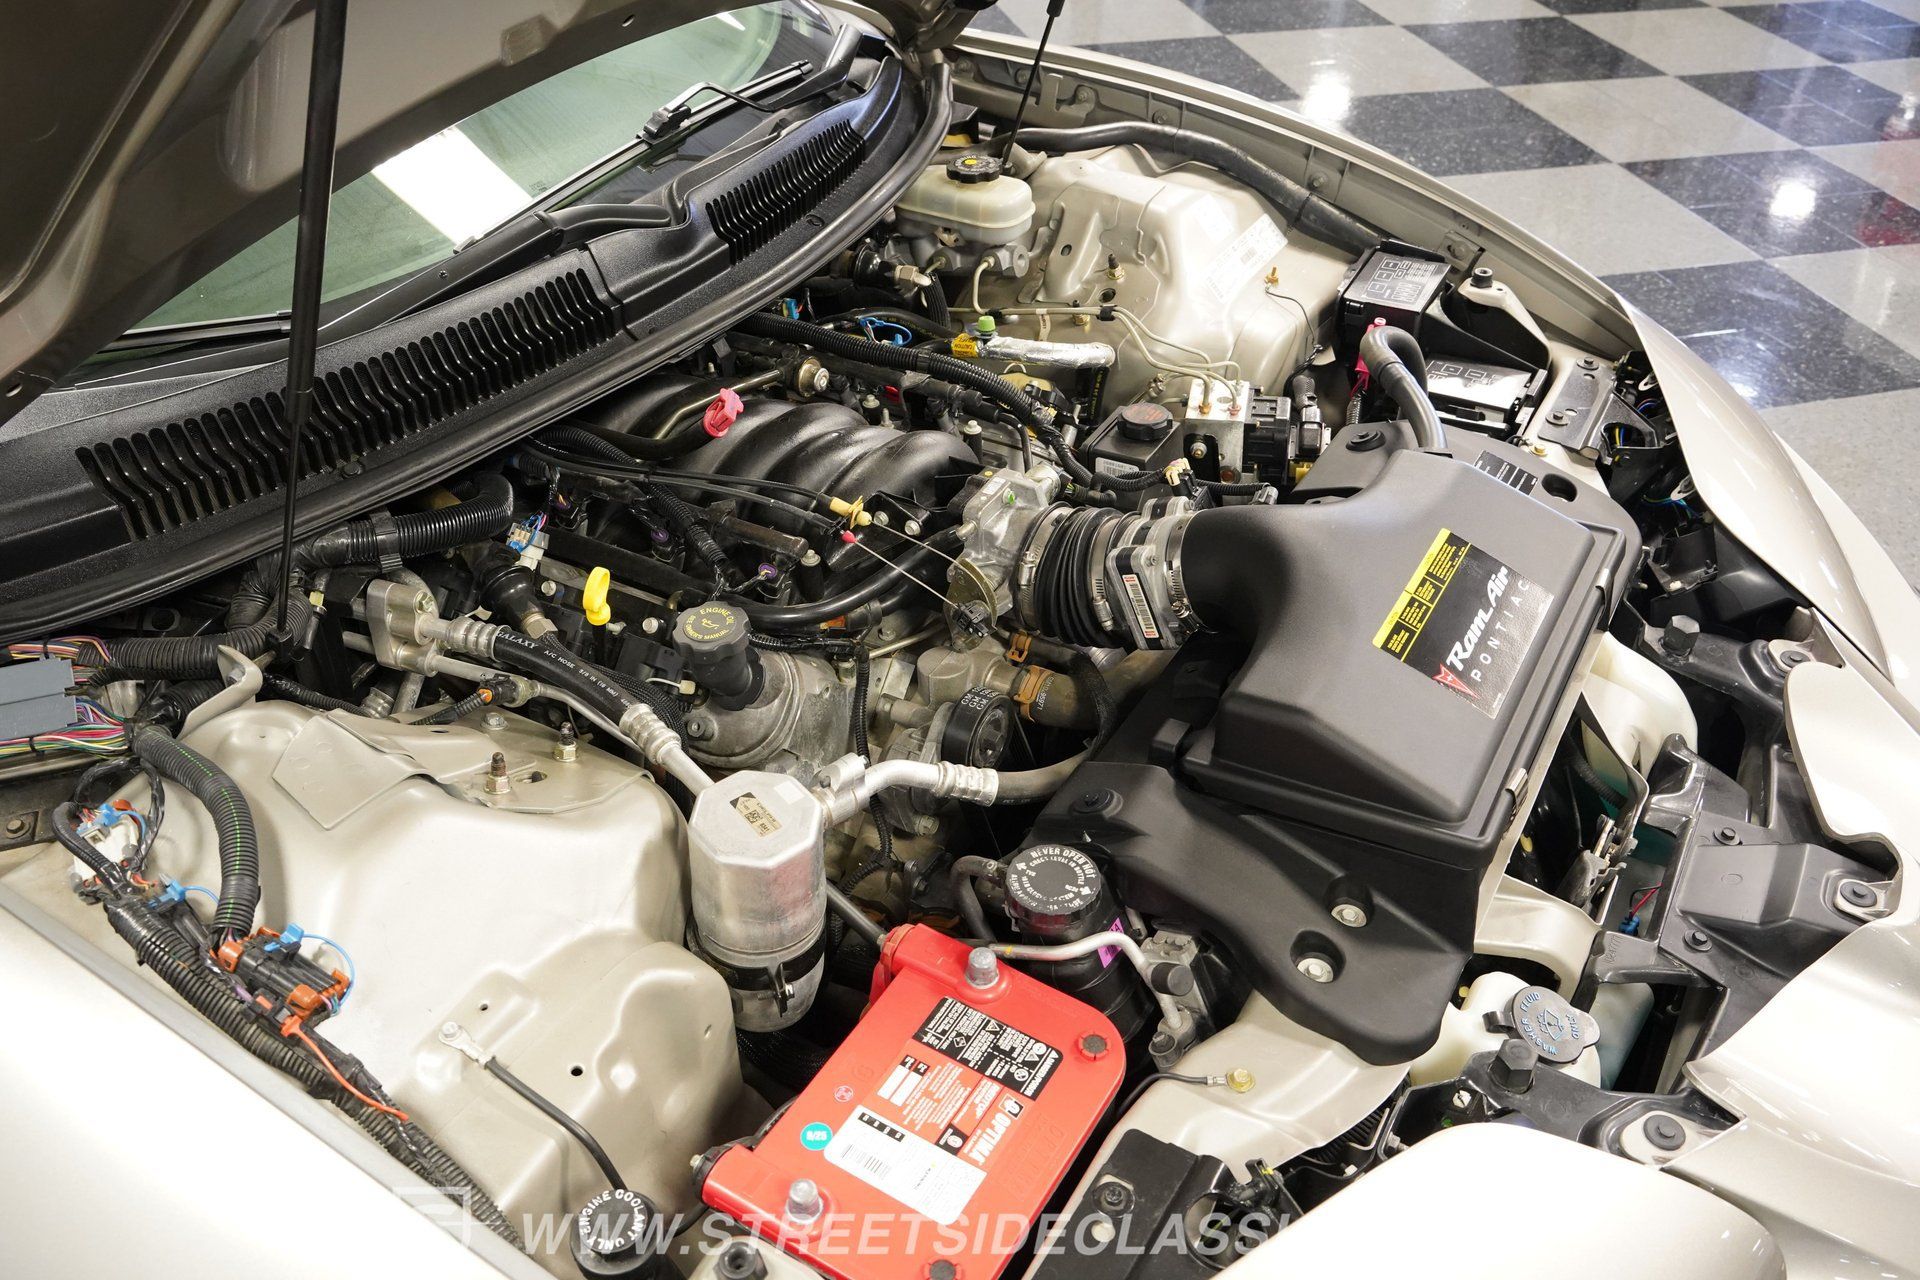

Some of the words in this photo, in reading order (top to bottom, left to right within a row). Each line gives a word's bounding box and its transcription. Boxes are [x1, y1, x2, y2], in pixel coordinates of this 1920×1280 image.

[700, 607, 731, 617] ENGINE
[726, 616, 734, 625] OIL
[1446, 608, 1493, 671] Ram
[1487, 566, 1509, 607] Air
[1471, 579, 1530, 682] PONTIAC
[704, 629, 730, 639] MANUAL
[496, 631, 538, 649] GALAXY
[544, 650, 557, 659] A/C
[558, 657, 576, 669] HOSE
[961, 693, 974, 704] GM
[969, 696, 981, 707] GM
[976, 698, 989, 710] GM
[1030, 847, 1060, 858] NEVER
[1063, 849, 1086, 864] OPEN
[1082, 863, 1097, 878] HOT
[1520, 992, 1540, 1013] FLUID
[1521, 1018, 1558, 1055] WASHER
[968, 1111, 1012, 1163] OPTIMA
[579, 1190, 611, 1235] ENGINE
[615, 1189, 645, 1240] COOLANT
[587, 1235, 625, 1250] ONLY
